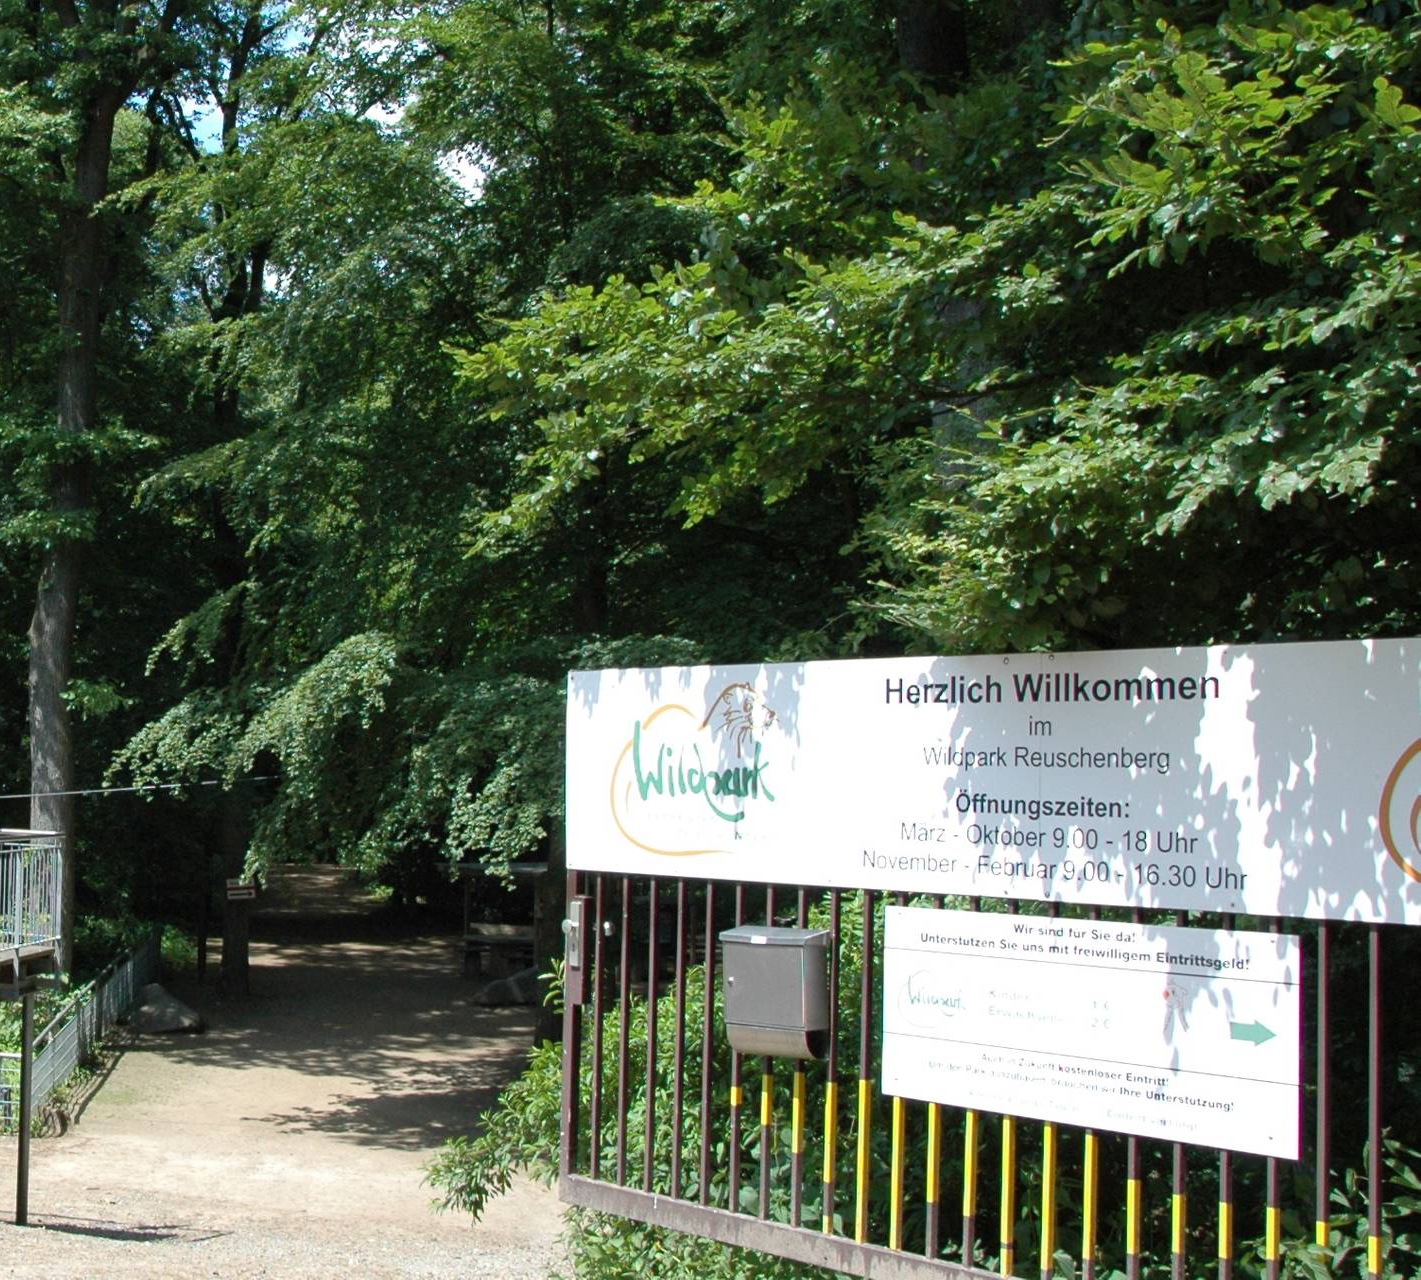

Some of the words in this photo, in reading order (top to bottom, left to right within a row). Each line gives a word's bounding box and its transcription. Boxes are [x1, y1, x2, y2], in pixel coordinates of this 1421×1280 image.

[885, 675, 1002, 704] Herzlich
[1013, 672, 1220, 703] Willkommen
[1029, 715, 1052, 737] im
[632, 719, 776, 823] Wildpark
[923, 746, 1007, 772] Wildpark
[1014, 746, 1170, 775] Reuschenberg
[955, 788, 1130, 820] Öffnungszeiten:
[900, 821, 947, 843] März
[966, 823, 1046, 848] Oktober
[1052, 827, 1099, 850] 9.00
[1122, 829, 1149, 852] 18
[1157, 830, 1199, 854] Uhr
[862, 848, 958, 873] November
[977, 854, 1057, 880] Februar
[1063, 859, 1110, 882] 9.00
[1134, 862, 1197, 888] 16.30
[1205, 865, 1248, 890] Uhr
[1013, 922, 1034, 935] Wir
[1038, 926, 1064, 938] sind
[1091, 928, 1111, 941] Sie
[1115, 931, 1136, 943] da!
[1000, 938, 1018, 951] Sie
[1022, 943, 1044, 954] uns
[1048, 943, 1069, 955] mit
[1073, 945, 1151, 963] freiwilligem
[1156, 951, 1250, 971] Eintrittsgeld!
[1058, 1063, 1123, 1081] kostenloser
[1126, 1071, 1169, 1088] Eintritt!
[1119, 1086, 1142, 1099] Ihre
